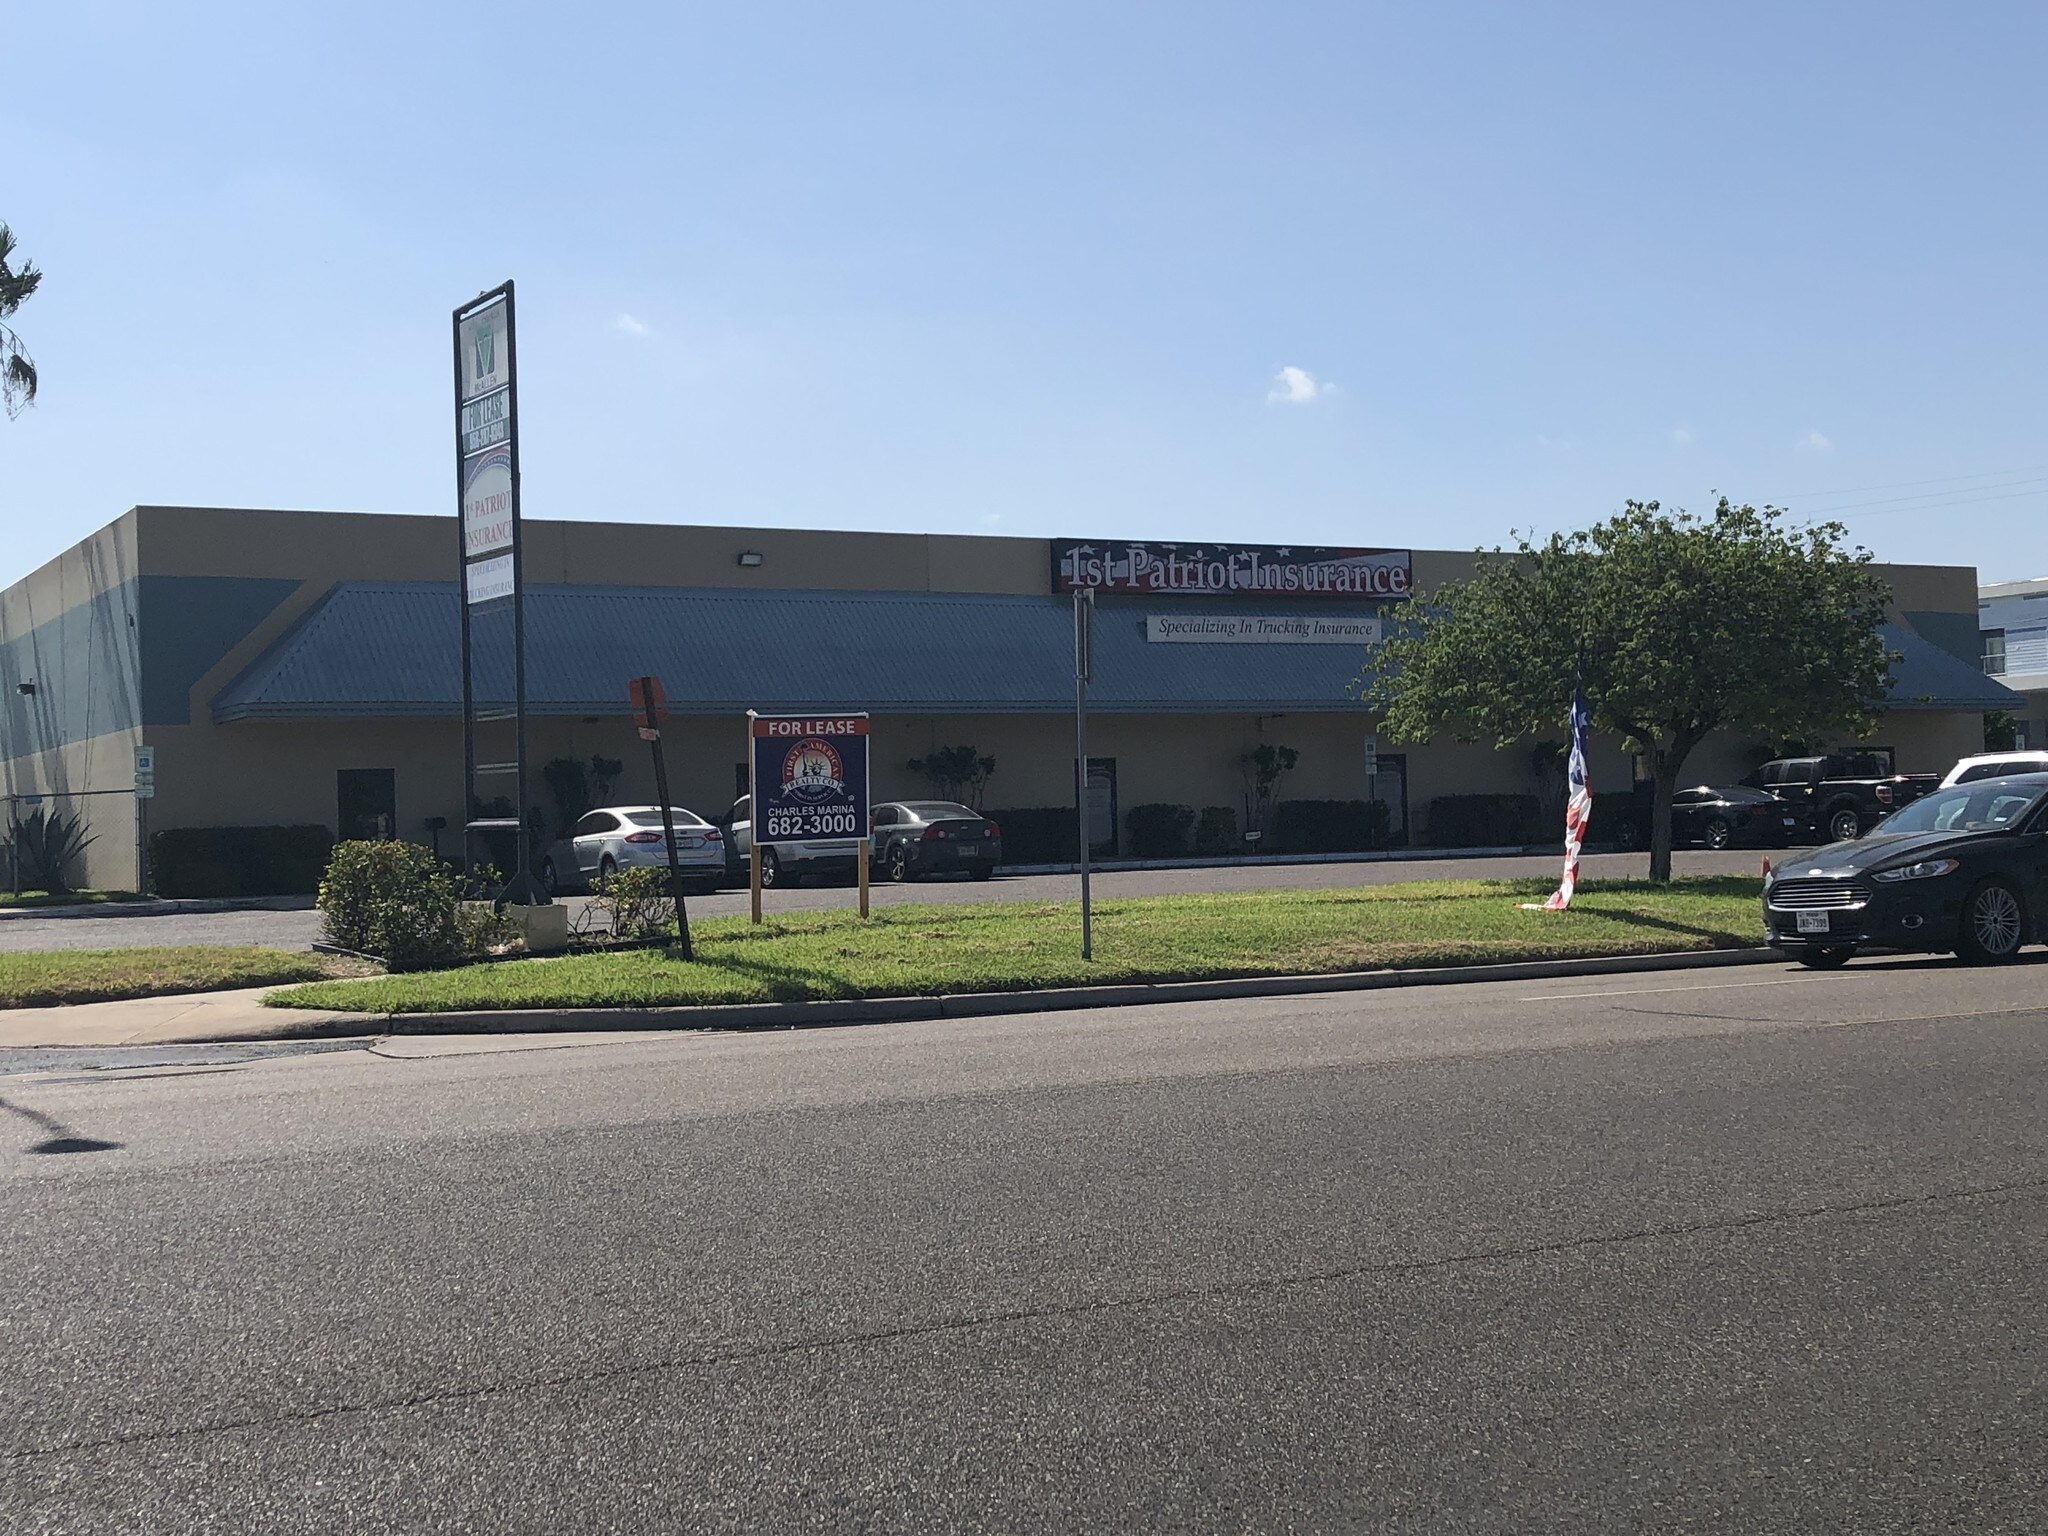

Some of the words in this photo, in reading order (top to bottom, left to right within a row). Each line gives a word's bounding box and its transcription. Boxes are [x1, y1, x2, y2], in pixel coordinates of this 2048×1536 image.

[469, 403, 481, 430] FOR
[482, 391, 503, 423] LEASE
[475, 490, 511, 518] PATRIOT
[1066, 547, 1115, 587] 1st
[1126, 548, 1240, 590] Patriot
[1249, 552, 1406, 593] Insurance
[1159, 618, 1236, 637] Specializing
[1240, 619, 1252, 634] In
[1257, 619, 1309, 637] Trucking
[1314, 620, 1373, 636] Insurance
[768, 721, 802, 735] FOR
[806, 720, 855, 735] LEASE
[786, 749, 800, 776] FIRST
[810, 742, 839, 779] AMERICAN
[788, 777, 821, 789] REALTY
[768, 806, 815, 817] CHARLES
[817, 804, 855, 815] MARINA
[768, 814, 856, 835] 682-3000
